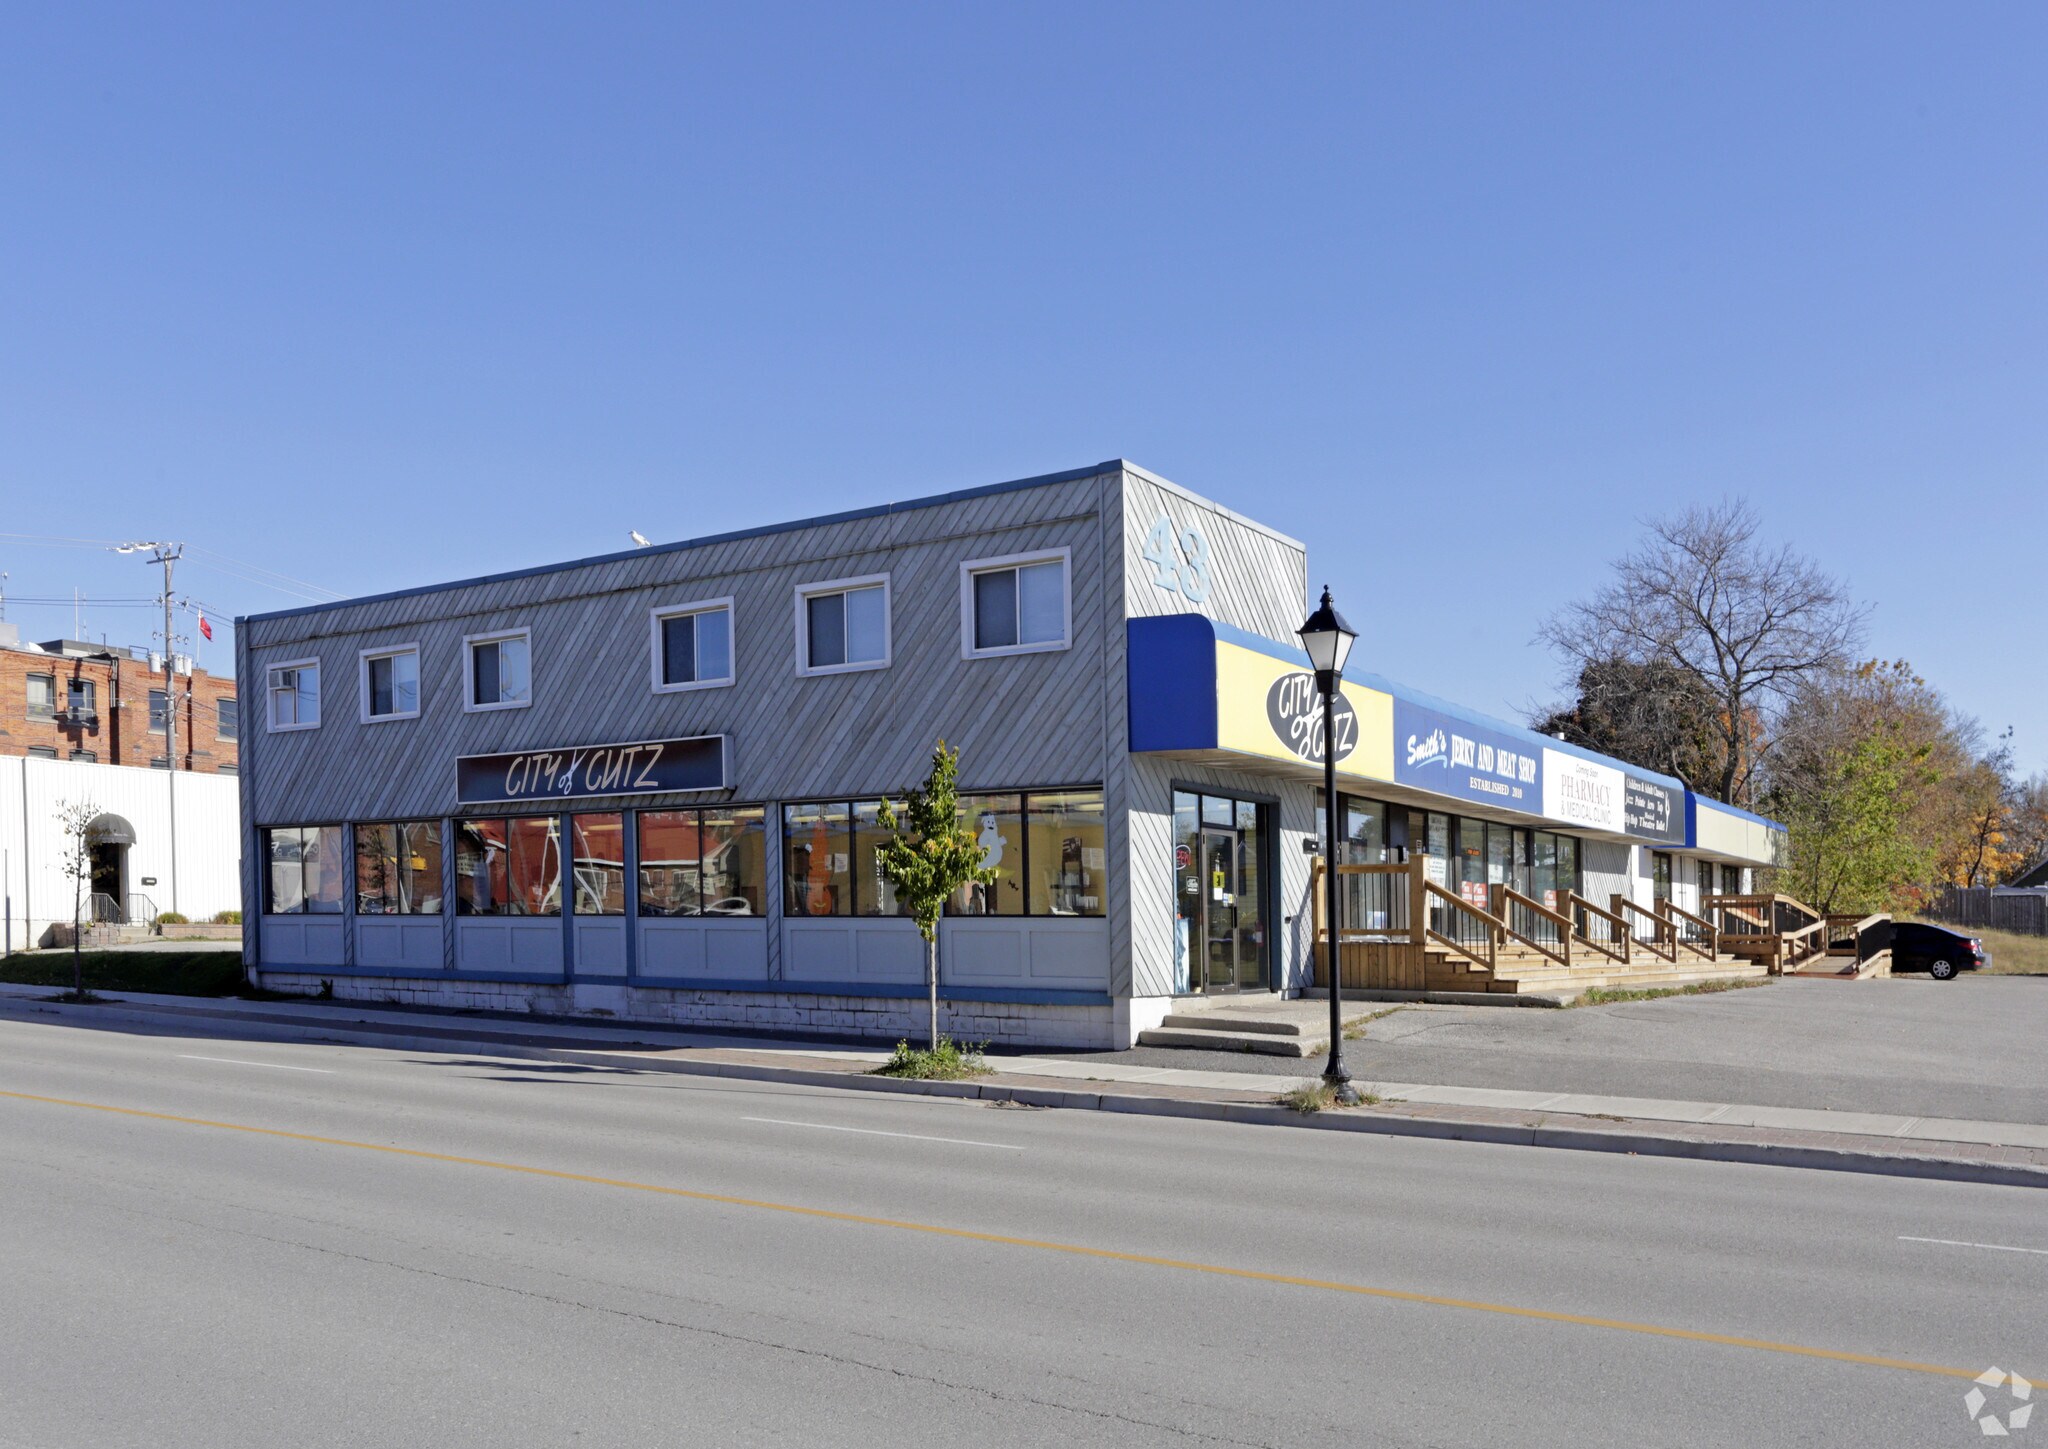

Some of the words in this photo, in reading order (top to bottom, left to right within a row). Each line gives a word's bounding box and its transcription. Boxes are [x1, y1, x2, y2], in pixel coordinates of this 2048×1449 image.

[1143, 514, 1211, 603] 43
[1279, 675, 1314, 718] CITY
[505, 753, 562, 796] CITY
[585, 744, 664, 791] CUTZ
[1407, 728, 1447, 765] Smith's
[1451, 734, 1475, 768] JERKY
[1478, 744, 1494, 772] AND
[1496, 748, 1517, 779] MEAT
[1519, 755, 1536, 784] SHOP
[1470, 777, 1509, 795] ESTABLISHED
[1561, 774, 1611, 807] PHARMACY
[1566, 801, 1592, 820] MEDICAL
[1593, 806, 1612, 825] CLINIC
